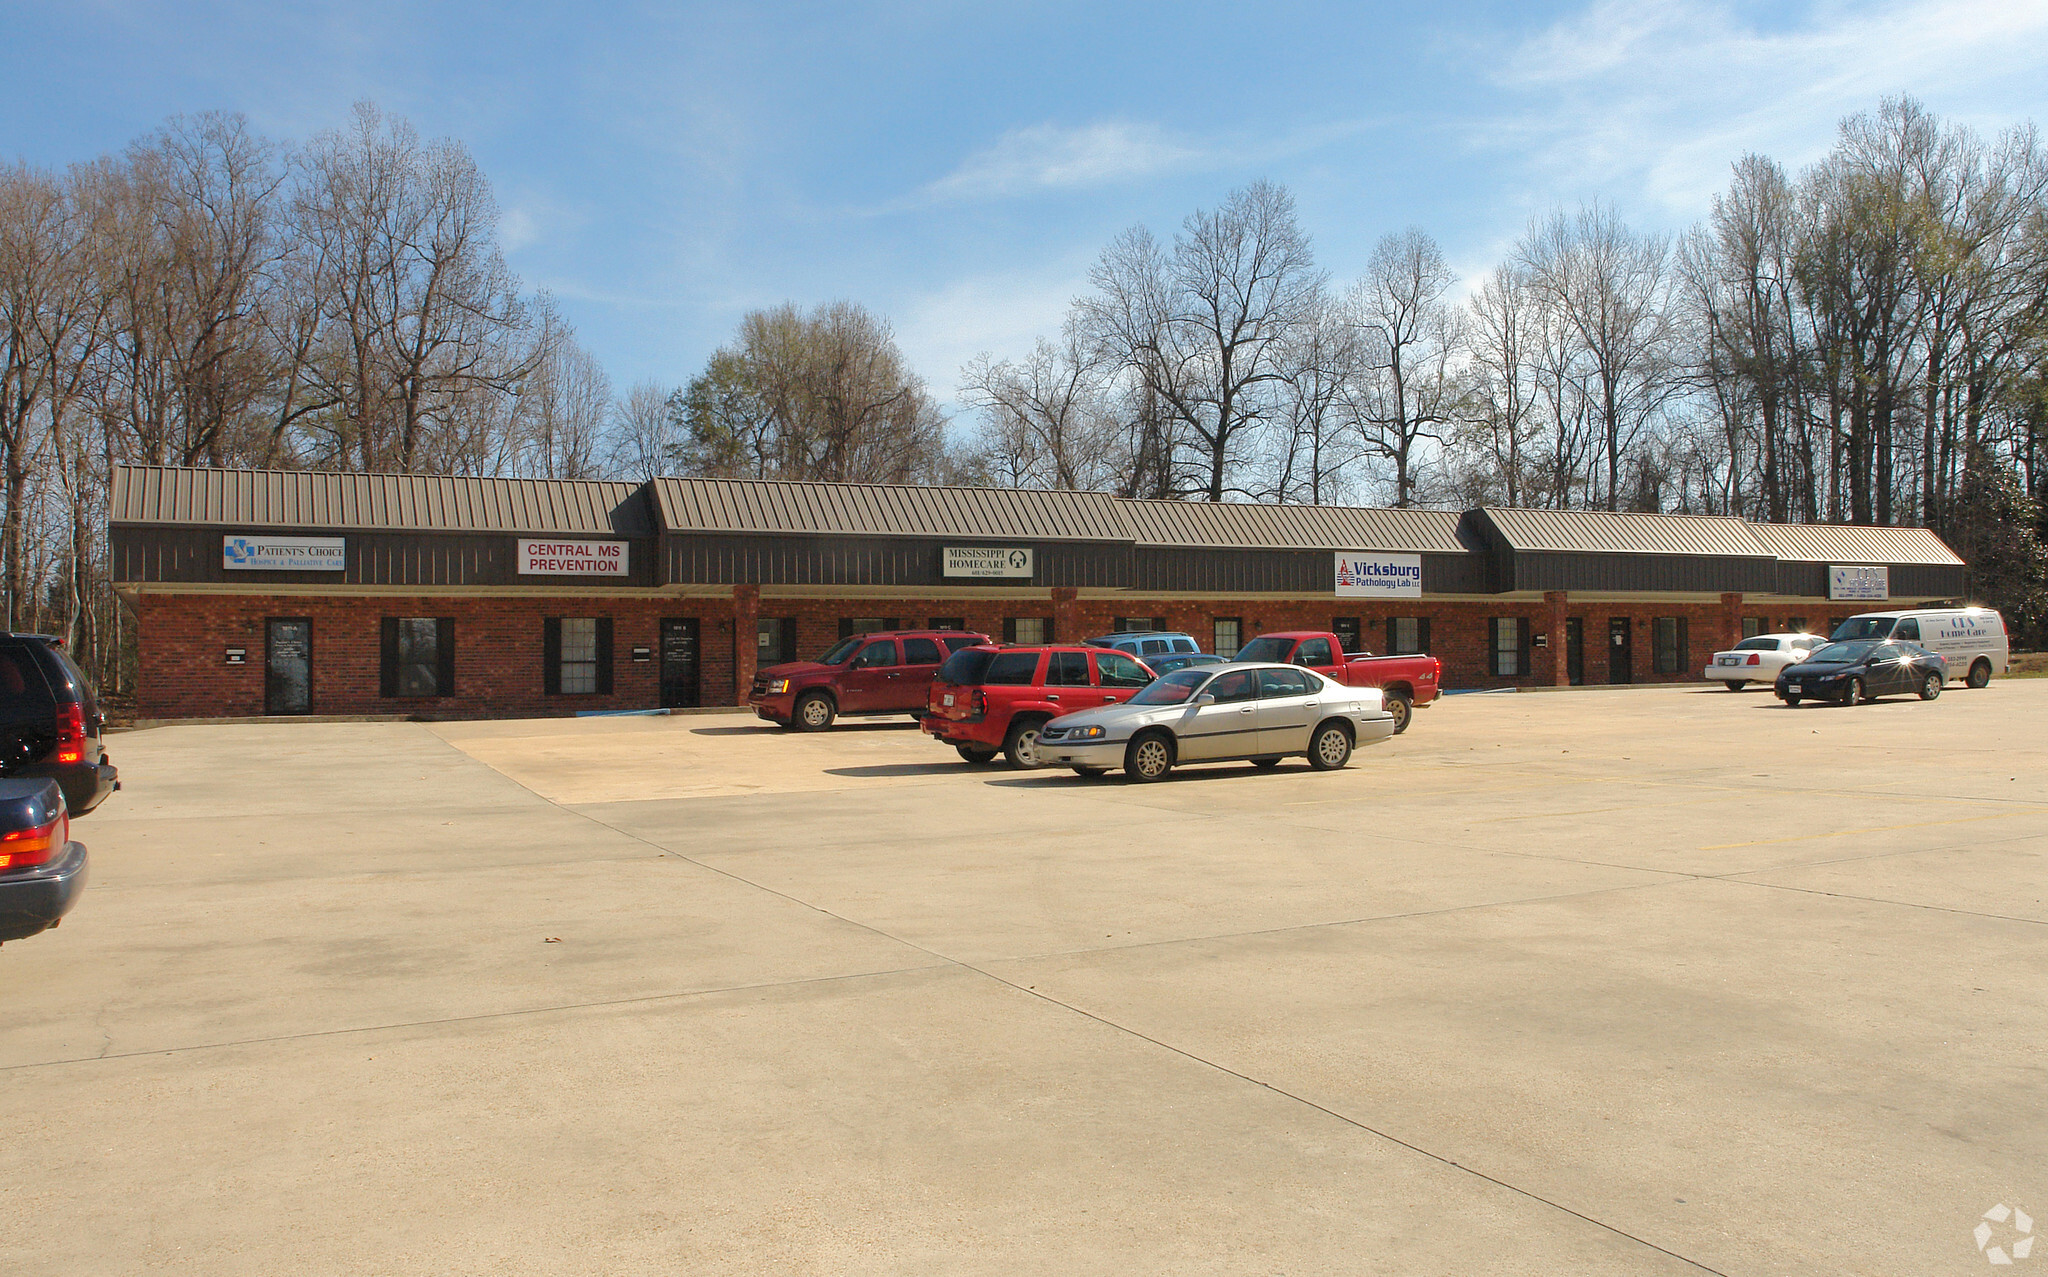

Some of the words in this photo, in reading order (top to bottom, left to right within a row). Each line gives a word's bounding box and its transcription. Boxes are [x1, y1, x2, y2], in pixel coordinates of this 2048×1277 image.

[257, 545, 305, 556] PATIENT'S
[308, 546, 344, 557] CHOICE
[528, 544, 592, 556] CENTRAL
[598, 545, 620, 557] MS
[949, 549, 1005, 558] MISSISSIPPI
[530, 559, 618, 571] PREVENTION
[949, 560, 1006, 568] HOMECARE
[1354, 562, 1420, 580] Vicksburg
[1356, 577, 1396, 589] Pathology
[1397, 578, 1411, 587] Lab
